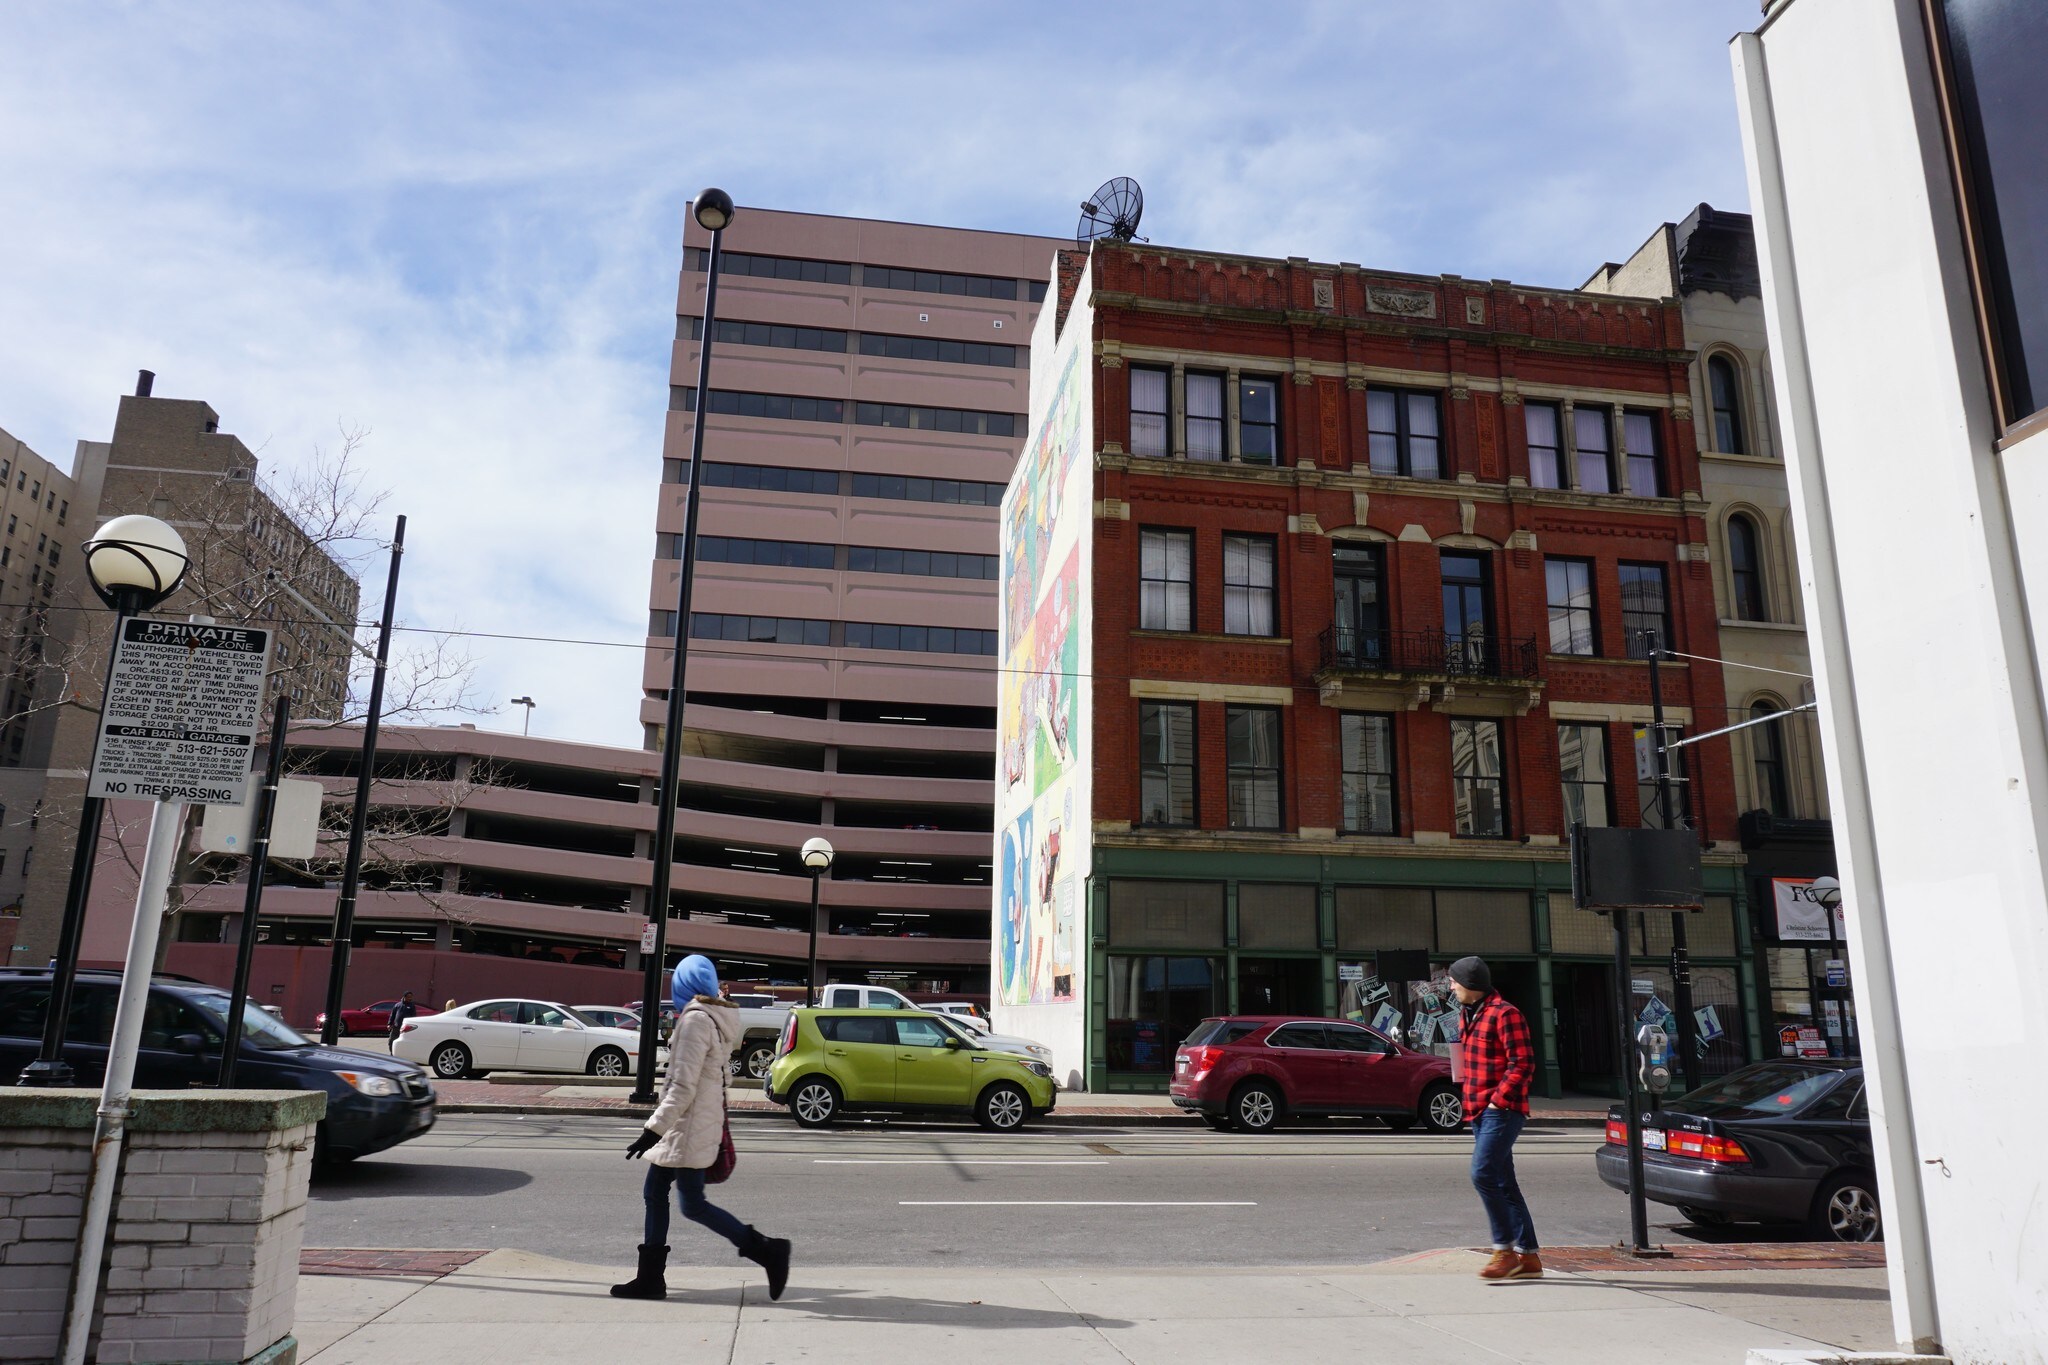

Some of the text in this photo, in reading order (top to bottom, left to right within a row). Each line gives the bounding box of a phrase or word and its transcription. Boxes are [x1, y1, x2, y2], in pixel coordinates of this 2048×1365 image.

[147, 623, 247, 642] PRIVATE
[137, 633, 168, 643] TOW
[216, 640, 254, 651] ZONE
[121, 643, 264, 662] UNAUTHORIZED VEHICLES ON
[144, 652, 190, 662] PROPERTY
[193, 656, 213, 664] WILL
[232, 660, 262, 669] TOWED
[119, 658, 145, 666] AWAY
[163, 661, 233, 674] ACCORDANCE
[237, 668, 262, 676] WITH
[115, 672, 168, 683] RECOVERED
[205, 680, 224, 688] TIME
[227, 682, 259, 691] DURING
[188, 671, 211, 679] CARS
[214, 673, 231, 681] MAY
[130, 688, 187, 699] OWNERSHIP
[201, 695, 244, 704] PAYMENT
[171, 685, 198, 693] NIGHT
[201, 687, 226, 695] UPON
[228, 689, 258, 698] PROOF
[110, 702, 150, 712] EXCEED
[154, 705, 190, 715] $90.00
[194, 708, 232, 718] TOWING
[236, 712, 243, 720] &
[111, 694, 139, 703] CASH
[155, 698, 174, 706] THE
[177, 700, 218, 709] AMOUNT
[220, 704, 240, 712] NOT
[108, 709, 148, 719] STORAGE
[150, 713, 185, 722] CHARGE
[207, 717, 218, 725] TO
[221, 719, 253, 728] EXCEED
[141, 720, 169, 728] $12.00
[120, 726, 240, 744] CAR BARN GARAGE
[122, 738, 153, 746] KINSEY
[102, 748, 126, 756] TRUCKS
[132, 751, 162, 759] TRACTORS
[176, 743, 248, 758] 513-621-5507
[138, 757, 163, 765] STORAGE
[172, 766, 201, 774] CHARGED
[105, 781, 232, 800] NO TRESPASSING
